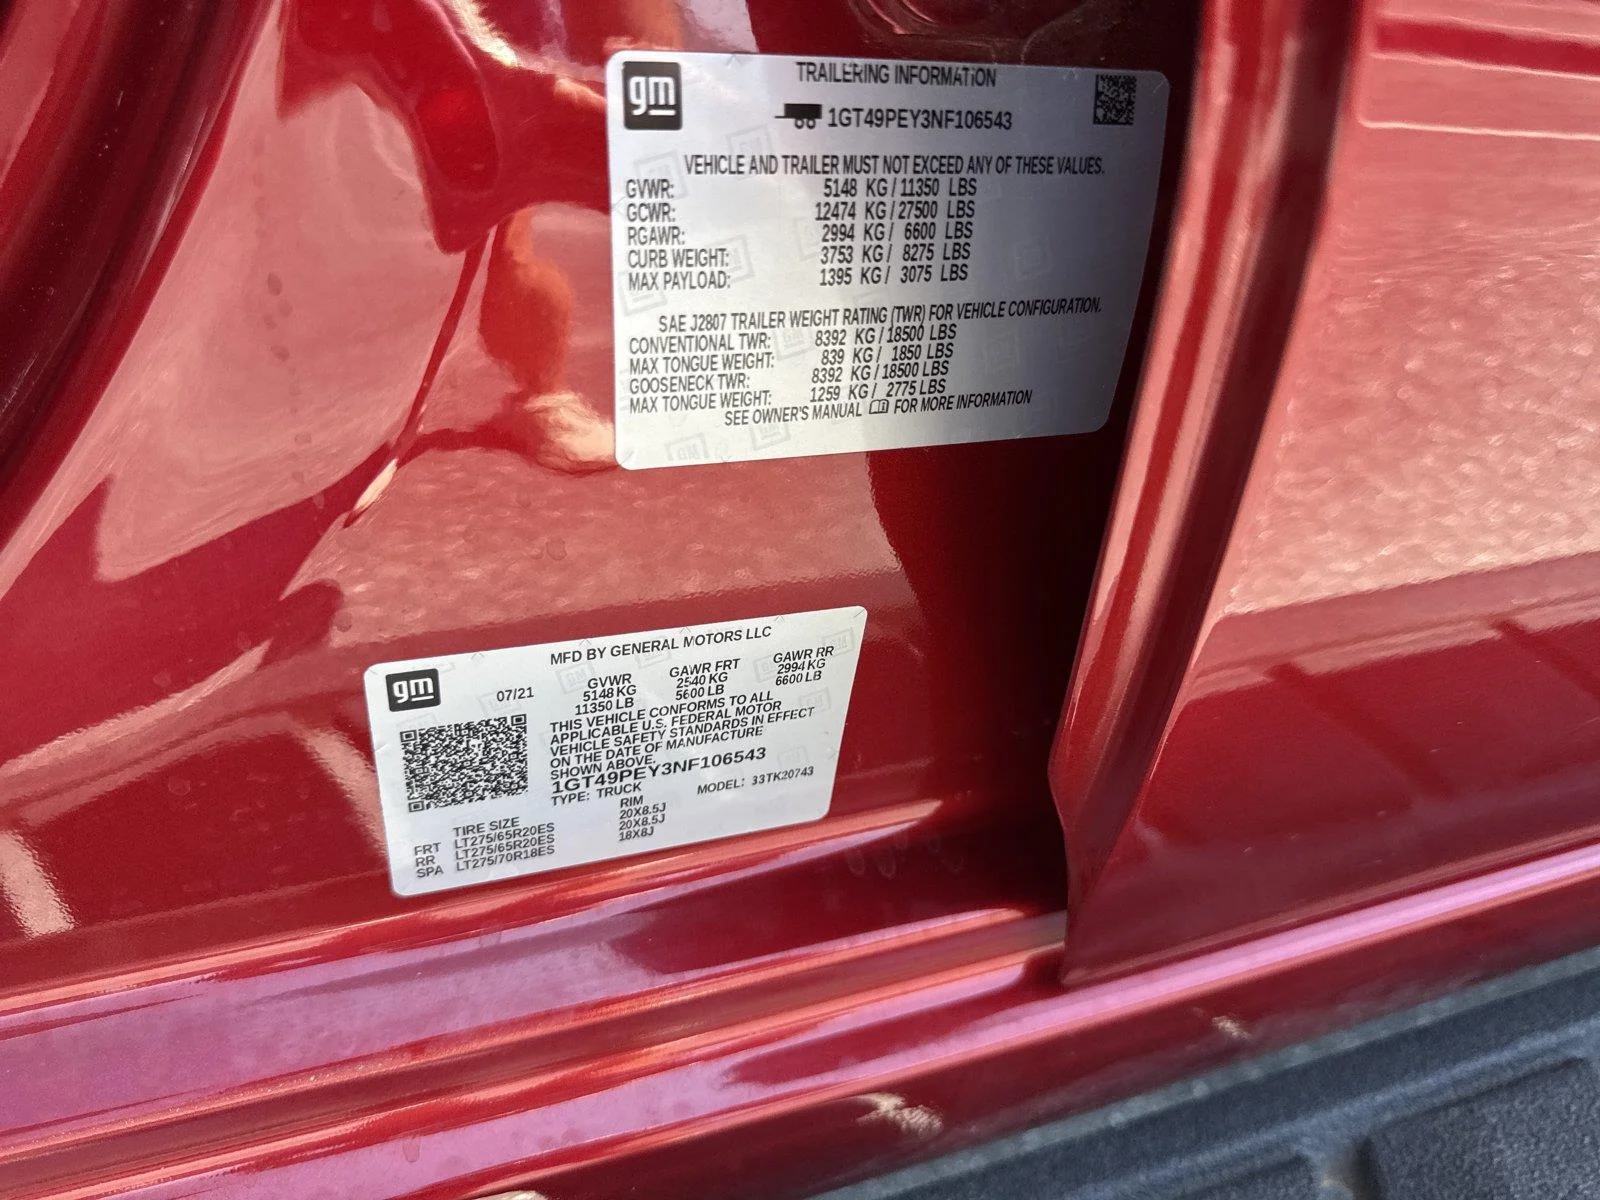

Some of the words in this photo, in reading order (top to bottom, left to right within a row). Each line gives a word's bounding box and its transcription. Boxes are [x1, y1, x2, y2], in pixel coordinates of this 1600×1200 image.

[796, 62, 889, 84] TRAILERING
[895, 65, 996, 87] INFORMATION
[828, 108, 1012, 130] 1GT49PEY3NF106543
[684, 155, 744, 174] VEHICLE
[750, 155, 778, 174] AND
[783, 155, 839, 174] TRAILER
[843, 156, 878, 174] MUST
[883, 156, 910, 174] NOT
[913, 156, 963, 174] EXCEED
[967, 156, 992, 174] ANY
[996, 156, 1012, 174] OF
[1016, 156, 1054, 174] THESE
[1057, 156, 1105, 174] VALUES.
[625, 179, 675, 198] GVWR:
[824, 178, 857, 197] 5148
[949, 178, 977, 196] LBS
[626, 203, 675, 222] GCWR:
[815, 202, 856, 221] 12474
[947, 200, 975, 219] LBS
[627, 226, 685, 246] RGAWR:
[821, 224, 855, 242] 2994
[904, 222, 936, 239] 6600
[945, 221, 973, 239] LBS
[628, 250, 668, 268] CURB
[673, 248, 729, 267] WEIGHT:
[821, 245, 853, 264] 3753
[903, 244, 934, 261] 8275
[943, 243, 971, 260] LBS
[629, 272, 659, 290] MAX
[663, 271, 730, 289] PAYLOAD:
[819, 267, 851, 286] 1395
[901, 265, 932, 282] 3075
[941, 263, 968, 281] LBS
[659, 315, 686, 332] SAE
[690, 314, 727, 332] J2807
[731, 311, 786, 330] TRAILER
[789, 309, 839, 327] WEIGHT
[843, 307, 888, 325] RATING
[891, 305, 926, 326] (TWR)
[929, 304, 953, 322] FOR
[957, 300, 1006, 320] VEHICLE
[1008, 298, 1102, 316] CONFIGURATION.
[630, 335, 734, 354] CONVENTIONAL
[739, 333, 771, 350] TWR:
[815, 329, 846, 347] 8392
[929, 324, 957, 341] LBS
[630, 357, 659, 375] MAX
[664, 355, 718, 373] TONGUE
[721, 352, 774, 370] WEIGHT:
[821, 350, 844, 365] 839
[892, 344, 921, 361] 1850
[926, 343, 953, 359] LBS
[630, 374, 715, 394] GOOSENECK
[718, 372, 750, 390] TWR:
[812, 367, 842, 384] 8392
[922, 360, 949, 377] LBS
[630, 396, 658, 414] MAX
[663, 394, 716, 411] TONGUE
[720, 389, 772, 408] WEIGHT:
[810, 386, 840, 403] 1259
[886, 380, 916, 398] 2775
[919, 378, 946, 396] LBS
[725, 410, 749, 426] SEE
[752, 405, 809, 424] OWNER'S
[812, 402, 862, 420] MANUAL
[894, 398, 918, 414] FOR
[921, 396, 954, 412] MORE
[956, 390, 1033, 410] INFORMATION
[550, 651, 582, 665] MFD
[586, 648, 606, 661] BY
[610, 638, 679, 657] GENERAL
[683, 629, 743, 647] MOTORS
[746, 626, 772, 641] LLC
[773, 649, 814, 664] GAWR
[816, 646, 834, 658] RR
[669, 663, 712, 678] GAWR
[714, 658, 741, 672] FRT
[777, 661, 806, 674] 2994
[807, 658, 826, 671] KG
[587, 674, 632, 690] GVWR
[677, 674, 706, 689] 2540
[708, 672, 728, 685] KG
[775, 673, 803, 686] 6600
[805, 670, 822, 682] LB
[496, 687, 534, 702] 07/21
[583, 688, 614, 702] 5148
[616, 684, 637, 697] KG
[675, 687, 705, 701] 5600
[707, 684, 724, 696] LB
[551, 719, 582, 733] THIS
[586, 709, 646, 728] VEHICLE
[650, 699, 726, 718] CONFORMS
[729, 694, 747, 707] TO
[750, 691, 774, 703] ALL
[575, 701, 613, 715] 11350
[616, 698, 634, 710] LB
[550, 723, 638, 745] APPLICABLE
[642, 717, 667, 731] U.S.
[671, 708, 731, 727] FEDERAL
[735, 701, 782, 717] MOTOR
[550, 738, 610, 757] VEHICLE
[613, 731, 666, 747] SAFETY
[669, 716, 748, 739] STANDARDS
[751, 713, 764, 725] IN
[767, 707, 815, 723] EFFECT
[550, 755, 572, 769] ON
[576, 751, 602, 764] THE
[605, 746, 641, 760] DATE
[644, 742, 663, 754] OF
[666, 726, 764, 750] MANUFACTURE
[550, 764, 603, 781] SHOWN
[606, 755, 656, 772] ABOVE.
[552, 747, 767, 794] 1GT49PEY3NF106543
[697, 778, 746, 795] MODEL:
[751, 766, 814, 786] 33TK20743
[551, 792, 590, 806] TYPE:
[597, 782, 643, 799] TRUCK
[620, 796, 644, 808] RIM
[619, 803, 666, 819] 20X8.5J
[619, 814, 665, 830] 20X8.5J
[453, 823, 486, 837] TIRE
[489, 817, 520, 832] SIZE
[454, 823, 555, 849] LT275/65R20ES
[619, 827, 654, 842] 18X8J
[414, 842, 441, 855] FRT
[455, 834, 555, 860] LT275/65R20ES
[416, 856, 435, 866] RR
[416, 866, 444, 878] SPA
